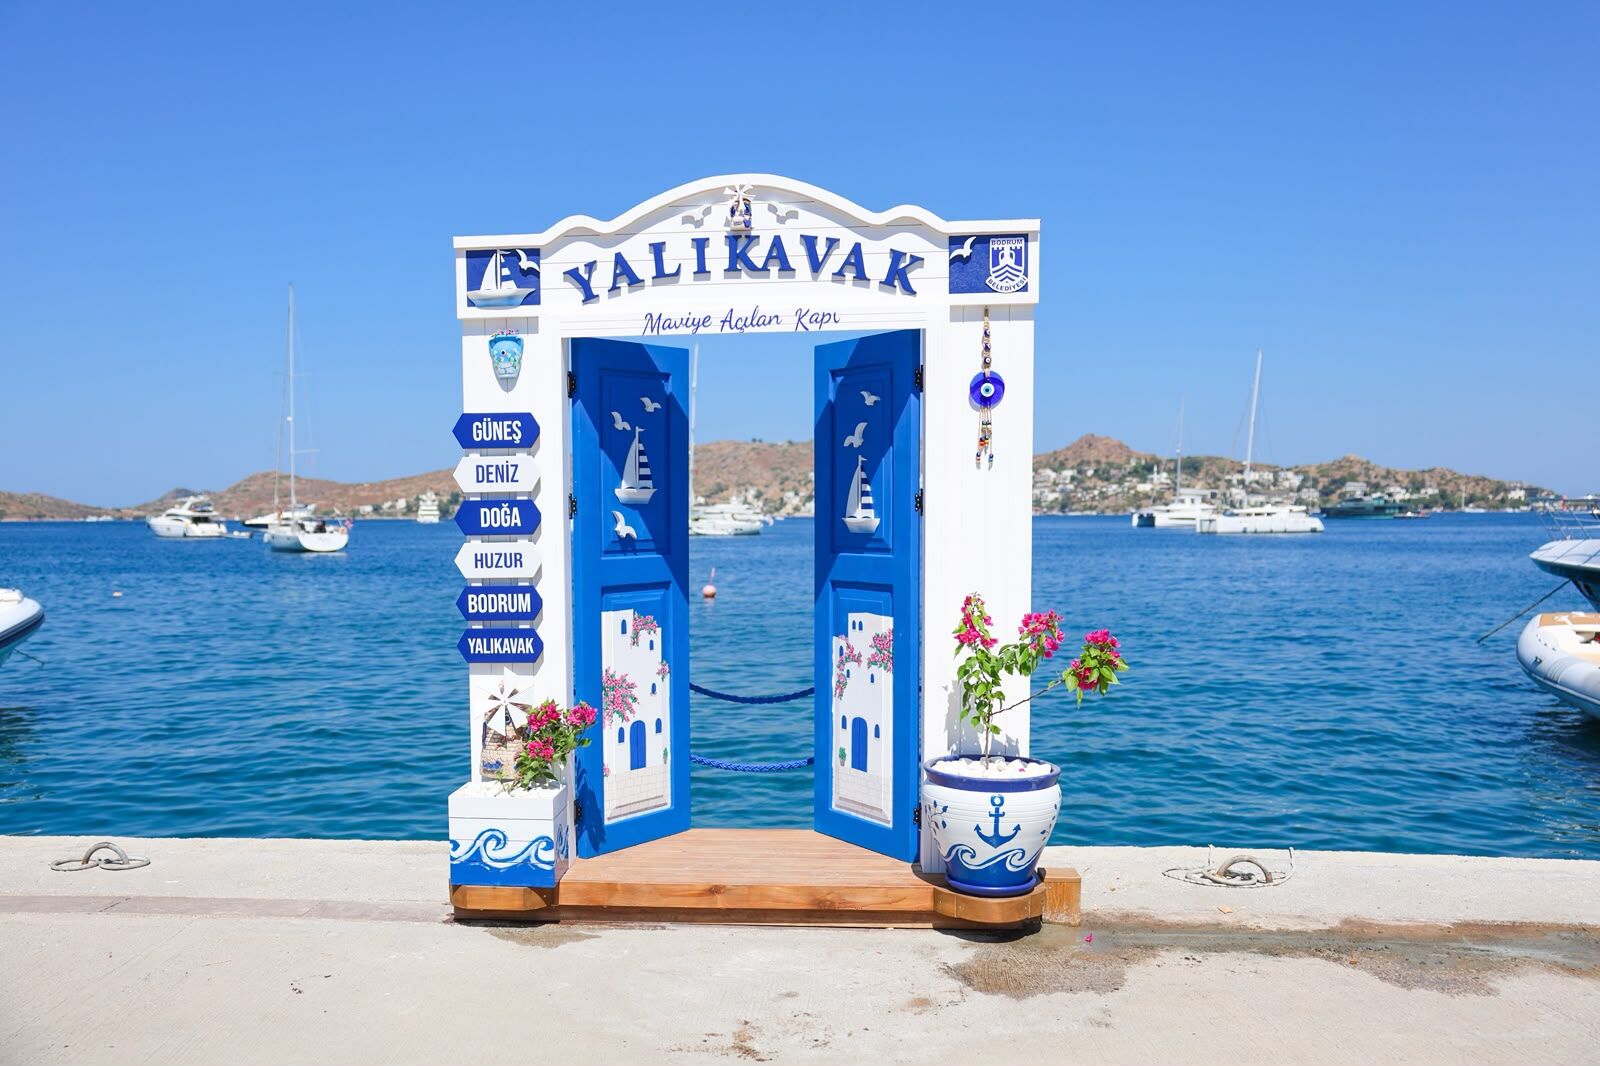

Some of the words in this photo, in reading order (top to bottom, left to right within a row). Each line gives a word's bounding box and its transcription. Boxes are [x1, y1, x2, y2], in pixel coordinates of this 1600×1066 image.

[563, 234, 924, 303] YALIKAVAK
[643, 312, 712, 335] Maviye
[795, 308, 840, 332] Kapı
[472, 417, 522, 443] GÜNEŞ
[475, 460, 519, 483] DENİZ
[480, 503, 521, 528] DOĞA
[474, 552, 523, 568] HUZUR
[467, 593, 531, 613] BODRUM
[467, 638, 534, 654] YALIKAVAK
